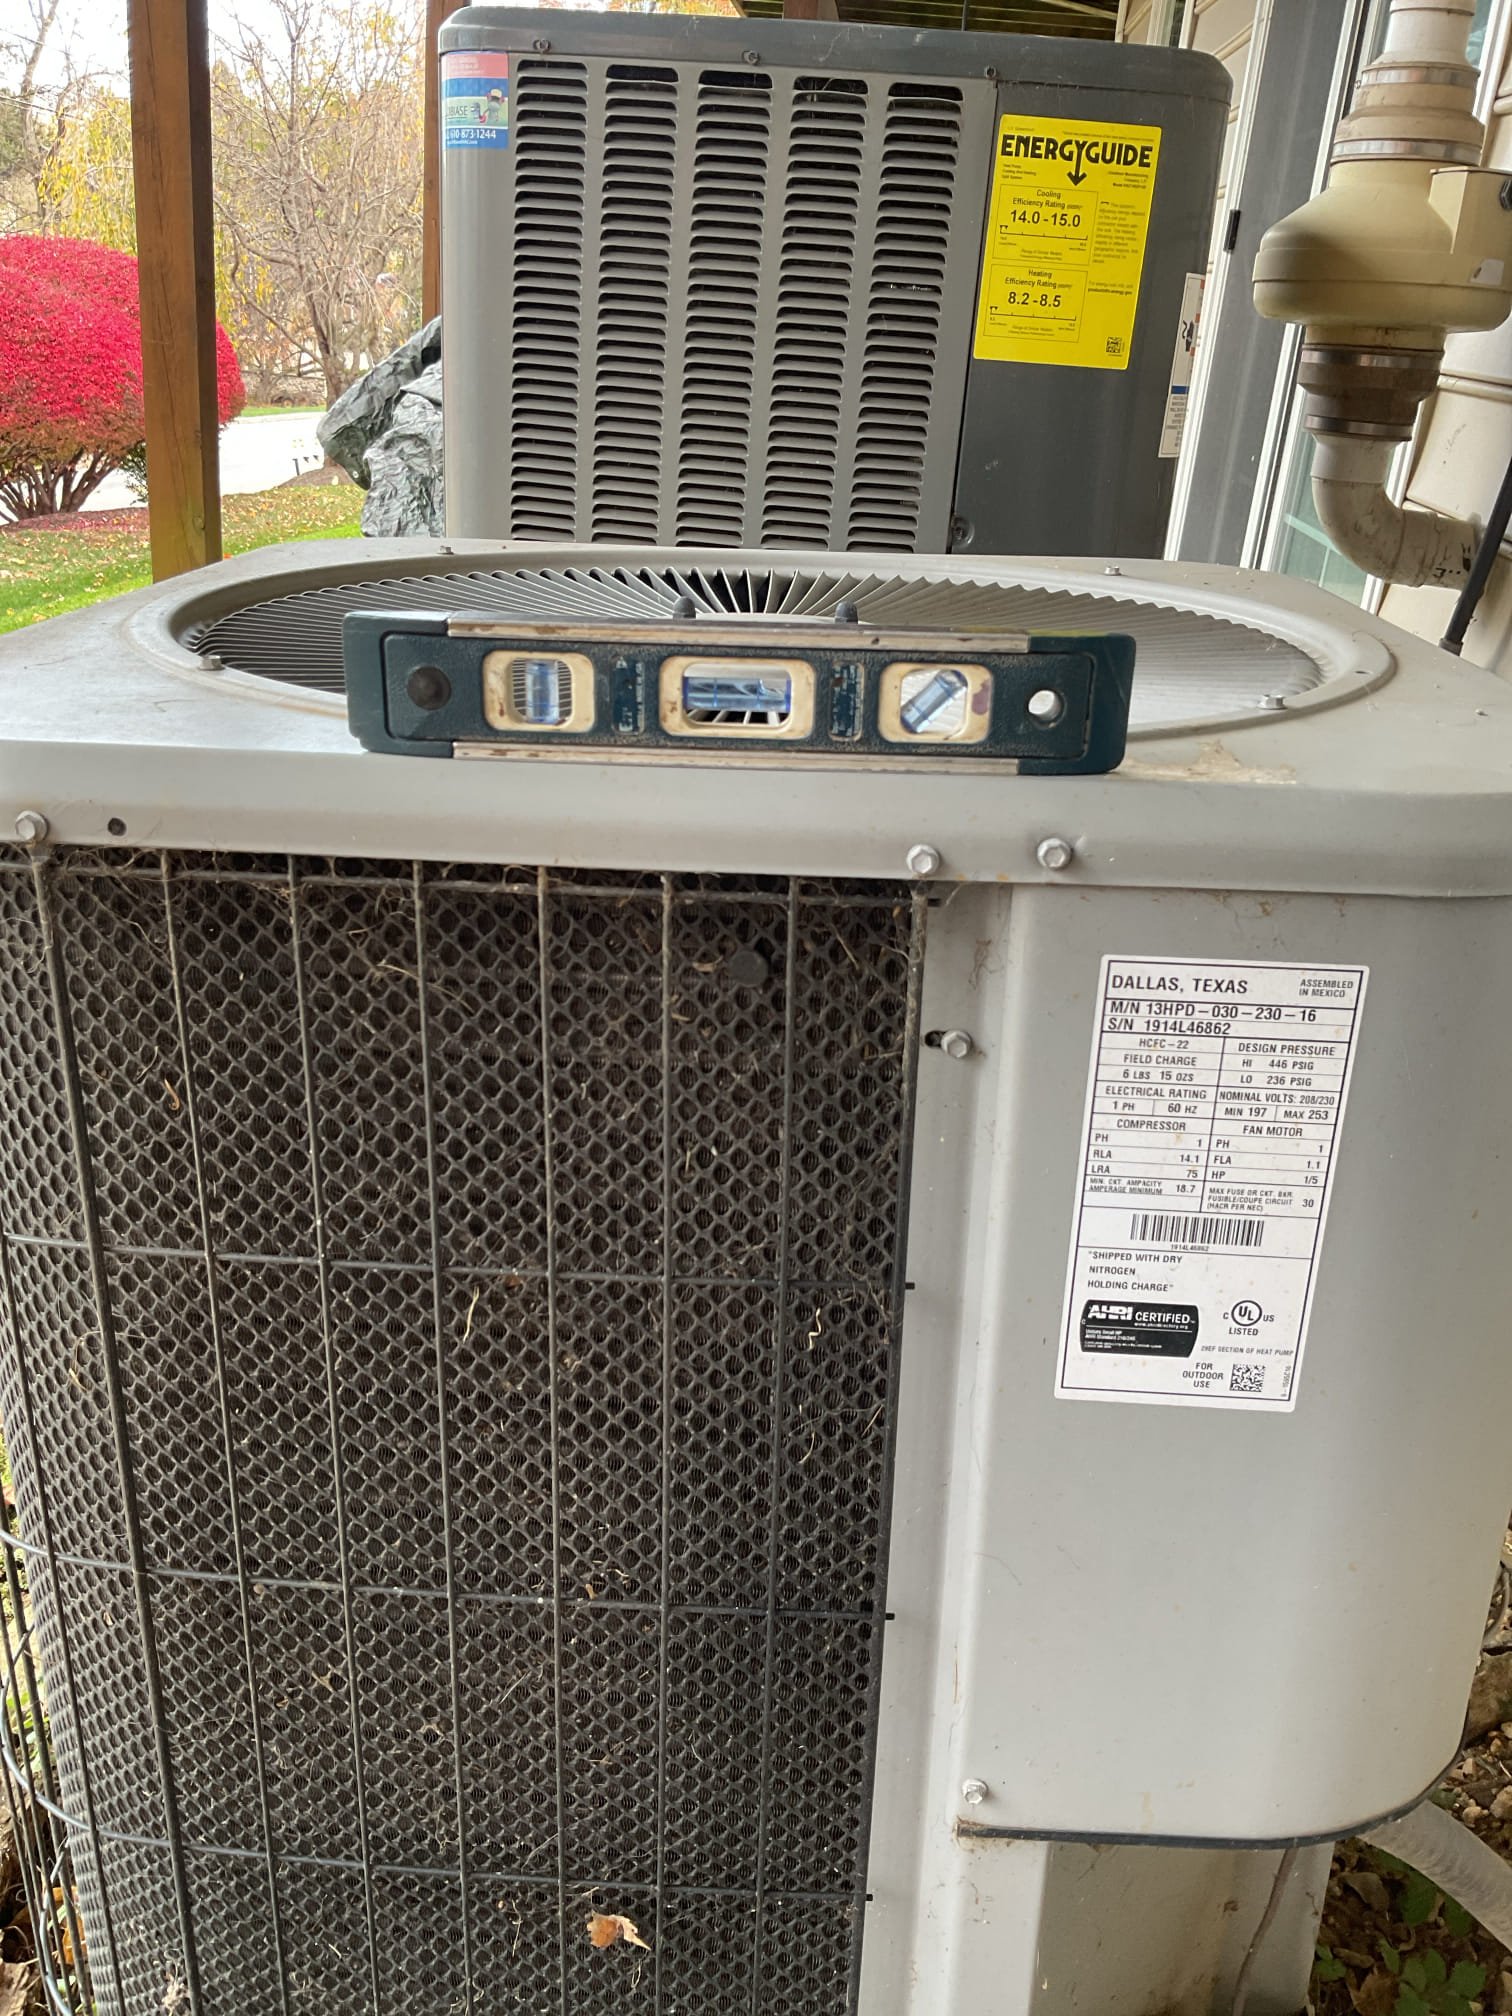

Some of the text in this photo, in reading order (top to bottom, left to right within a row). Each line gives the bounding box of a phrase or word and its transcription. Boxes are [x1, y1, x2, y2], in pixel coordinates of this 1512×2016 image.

[1001, 134, 1153, 168] ENERGYGUIDE
[1037, 189, 1061, 199] Cooling
[1013, 198, 1043, 208] Efficiency
[1045, 200, 1065, 209] Rating
[1029, 270, 1052, 279] Heating
[1005, 277, 1035, 287] Efficiency
[1037, 280, 1056, 289] Rating
[1112, 975, 1248, 994] DALLAS, TEXAS
[1300, 979, 1354, 989] ASSEMBLED
[1312, 989, 1346, 998] MEXICO
[1110, 1001, 1140, 1014] M/N
[1108, 1018, 1231, 1035] S/N 1914L46862
[1238, 1042, 1336, 1056] DESIGN PRESSURE
[1123, 1054, 1197, 1067] FIELD CHARGE
[1242, 1059, 1314, 1071] HI 446 PSIG
[1123, 1069, 1194, 1082] 6 LBS 15 OZS
[1240, 1075, 1312, 1087] LO 236 PSIG
[1106, 1086, 1207, 1100] ELECTRICAL RATING
[1219, 1091, 1335, 1106] NOMINAL VOLTS: 208/230
[1113, 1100, 1197, 1115] 1 PH 60 HZ
[1224, 1107, 1328, 1121] MIN 197 MAX 253
[1116, 1119, 1186, 1132] COMPRESSOR
[1243, 1125, 1303, 1137] FAN MOTOR
[1095, 1133, 1202, 1148] PH 1
[1216, 1139, 1323, 1153] PH 1
[1093, 1149, 1199, 1164] RLA 14.1
[1213, 1155, 1320, 1170] FLA 1.1
[1091, 1164, 1198, 1179] LRA 75
[1211, 1170, 1318, 1185] HP 1/5
[1176, 1184, 1196, 1193] 18.7
[1227, 1188, 1245, 1196] FUSE
[1302, 1199, 1314, 1208] 30
[1135, 1253, 1160, 1263] WITH
[1163, 1254, 1183, 1264] DRY
[1089, 1266, 1136, 1276] NITROGEN
[1088, 1279, 1128, 1291] HOLDING
[1087, 1305, 1190, 1324] AHRI CERTIFIED
[1239, 1306, 1254, 1320] UL
[1229, 1327, 1258, 1336] LISTED
[1183, 1371, 1224, 1380] OUTDOOR
